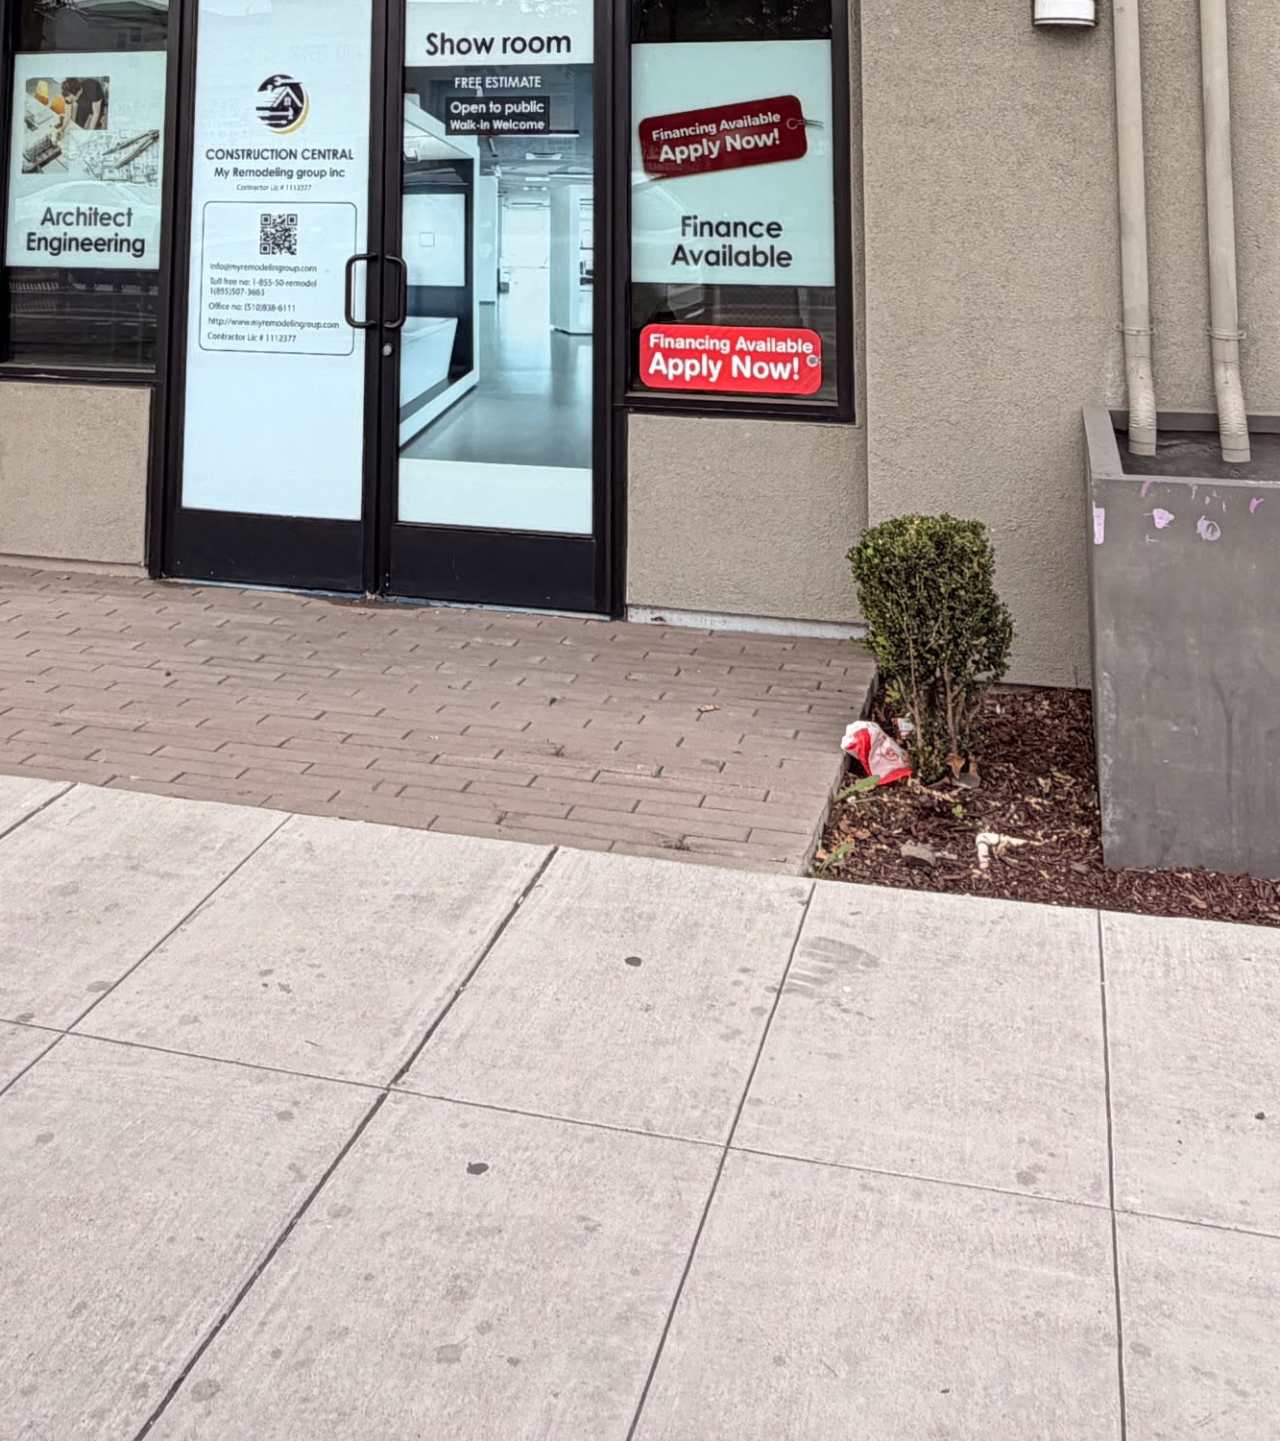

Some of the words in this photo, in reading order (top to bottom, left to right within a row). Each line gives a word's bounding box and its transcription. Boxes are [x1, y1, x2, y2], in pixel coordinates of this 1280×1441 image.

[425, 32, 495, 56] Show
[502, 35, 571, 54] room
[454, 76, 482, 89] FREE
[485, 75, 542, 88] ESTIMATE
[450, 101, 486, 115] Open
[489, 101, 502, 113] to
[504, 100, 545, 115] public
[450, 119, 490, 130] Walk-in
[492, 119, 545, 130] Welcome
[652, 123, 717, 142] Financing
[720, 112, 781, 131] Available
[205, 148, 298, 160] CONSTRUCTION
[301, 148, 354, 160] CENTRAL
[659, 138, 721, 164] Apply
[724, 128, 780, 152] Now!
[214, 166, 230, 179] My
[233, 166, 294, 179] Remodeling
[296, 168, 327, 179] group
[329, 167, 346, 177] inc
[40, 206, 134, 228] Architect
[681, 215, 783, 238] Finance
[26, 232, 146, 258] Engineering
[671, 243, 793, 268] Available
[208, 302, 230, 311] Office
[207, 332, 246, 341] Contractor
[649, 333, 730, 353] Financing
[735, 336, 814, 353] Available
[648, 351, 722, 383] Apply
[731, 354, 800, 381] Now!
